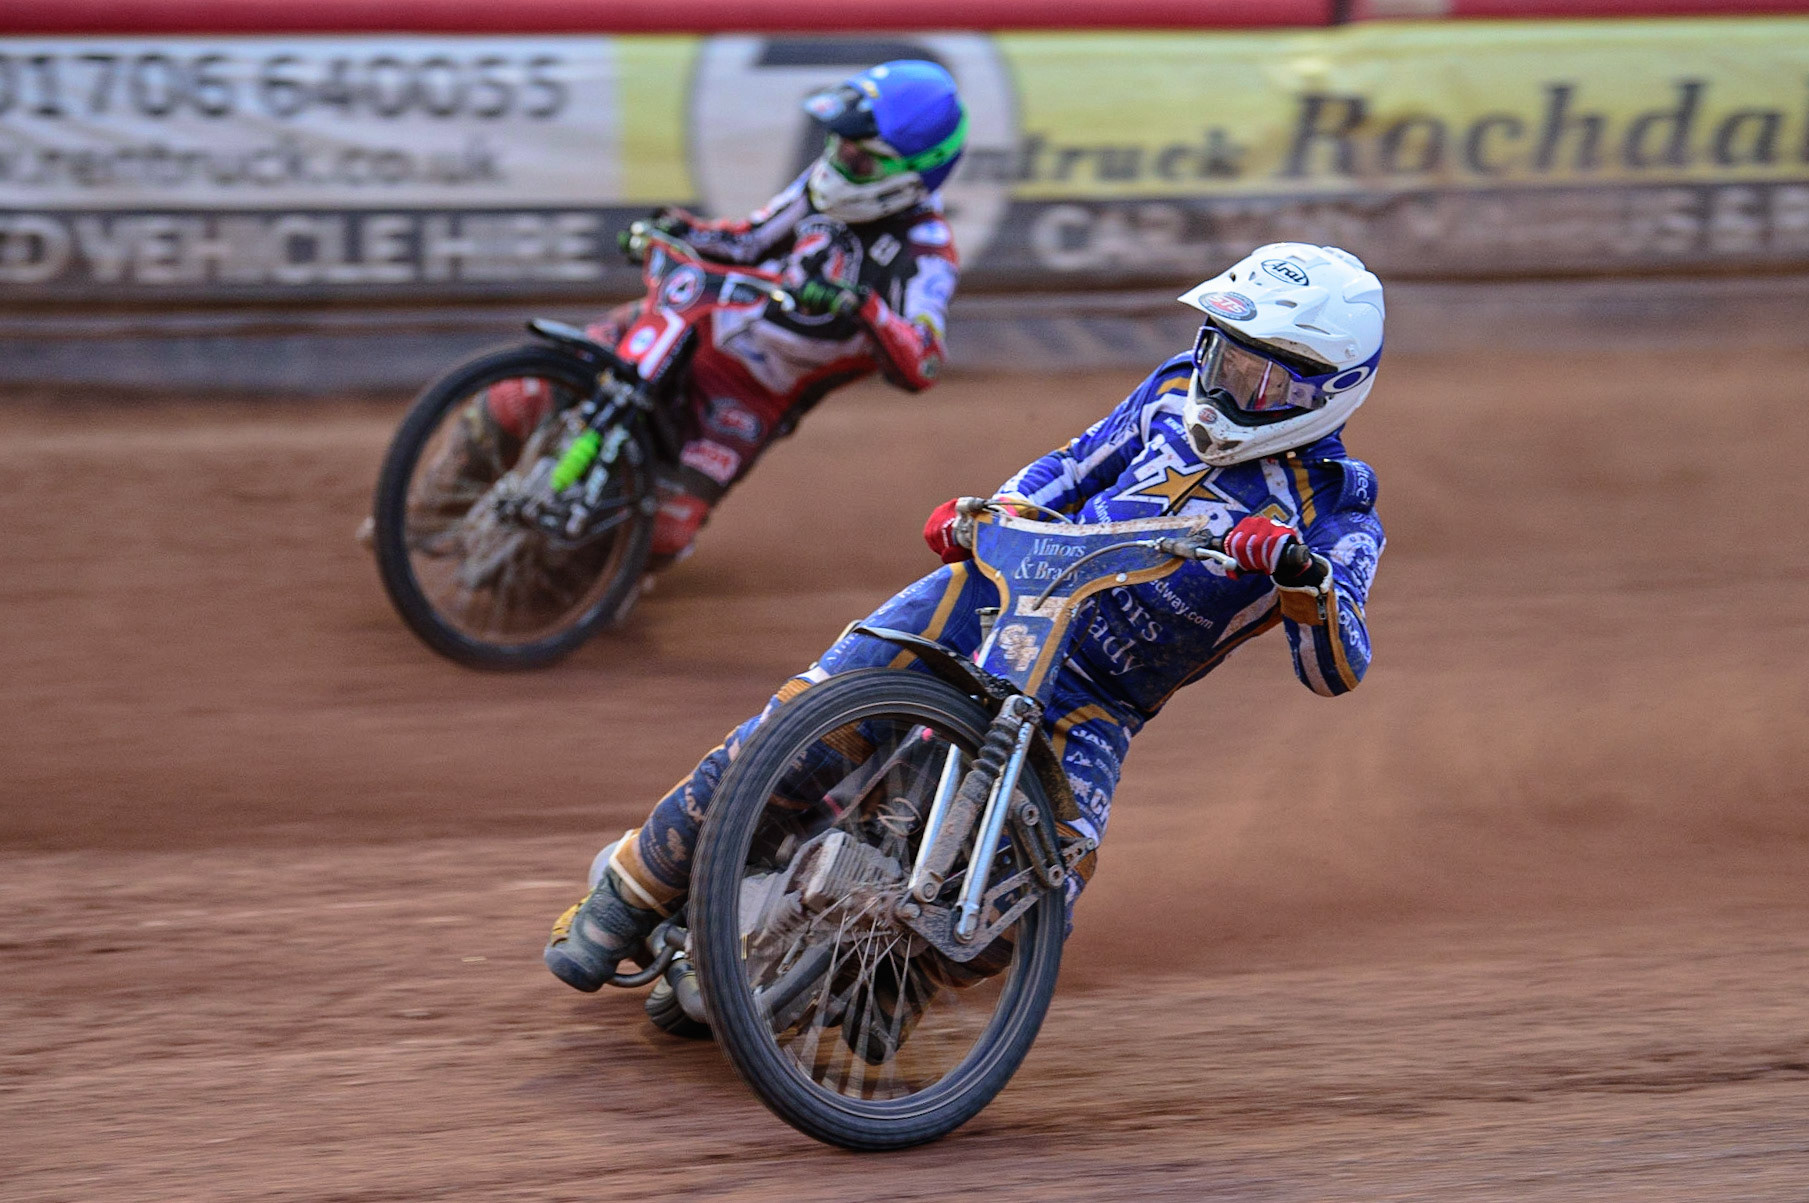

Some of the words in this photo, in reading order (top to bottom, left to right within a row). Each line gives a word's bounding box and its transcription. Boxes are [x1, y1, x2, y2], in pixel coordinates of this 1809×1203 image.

[1278, 78, 1809, 180] Rochda
[1272, 261, 1304, 283] Arai
[1029, 537, 1087, 557] Minors
[1014, 556, 1034, 580] &
